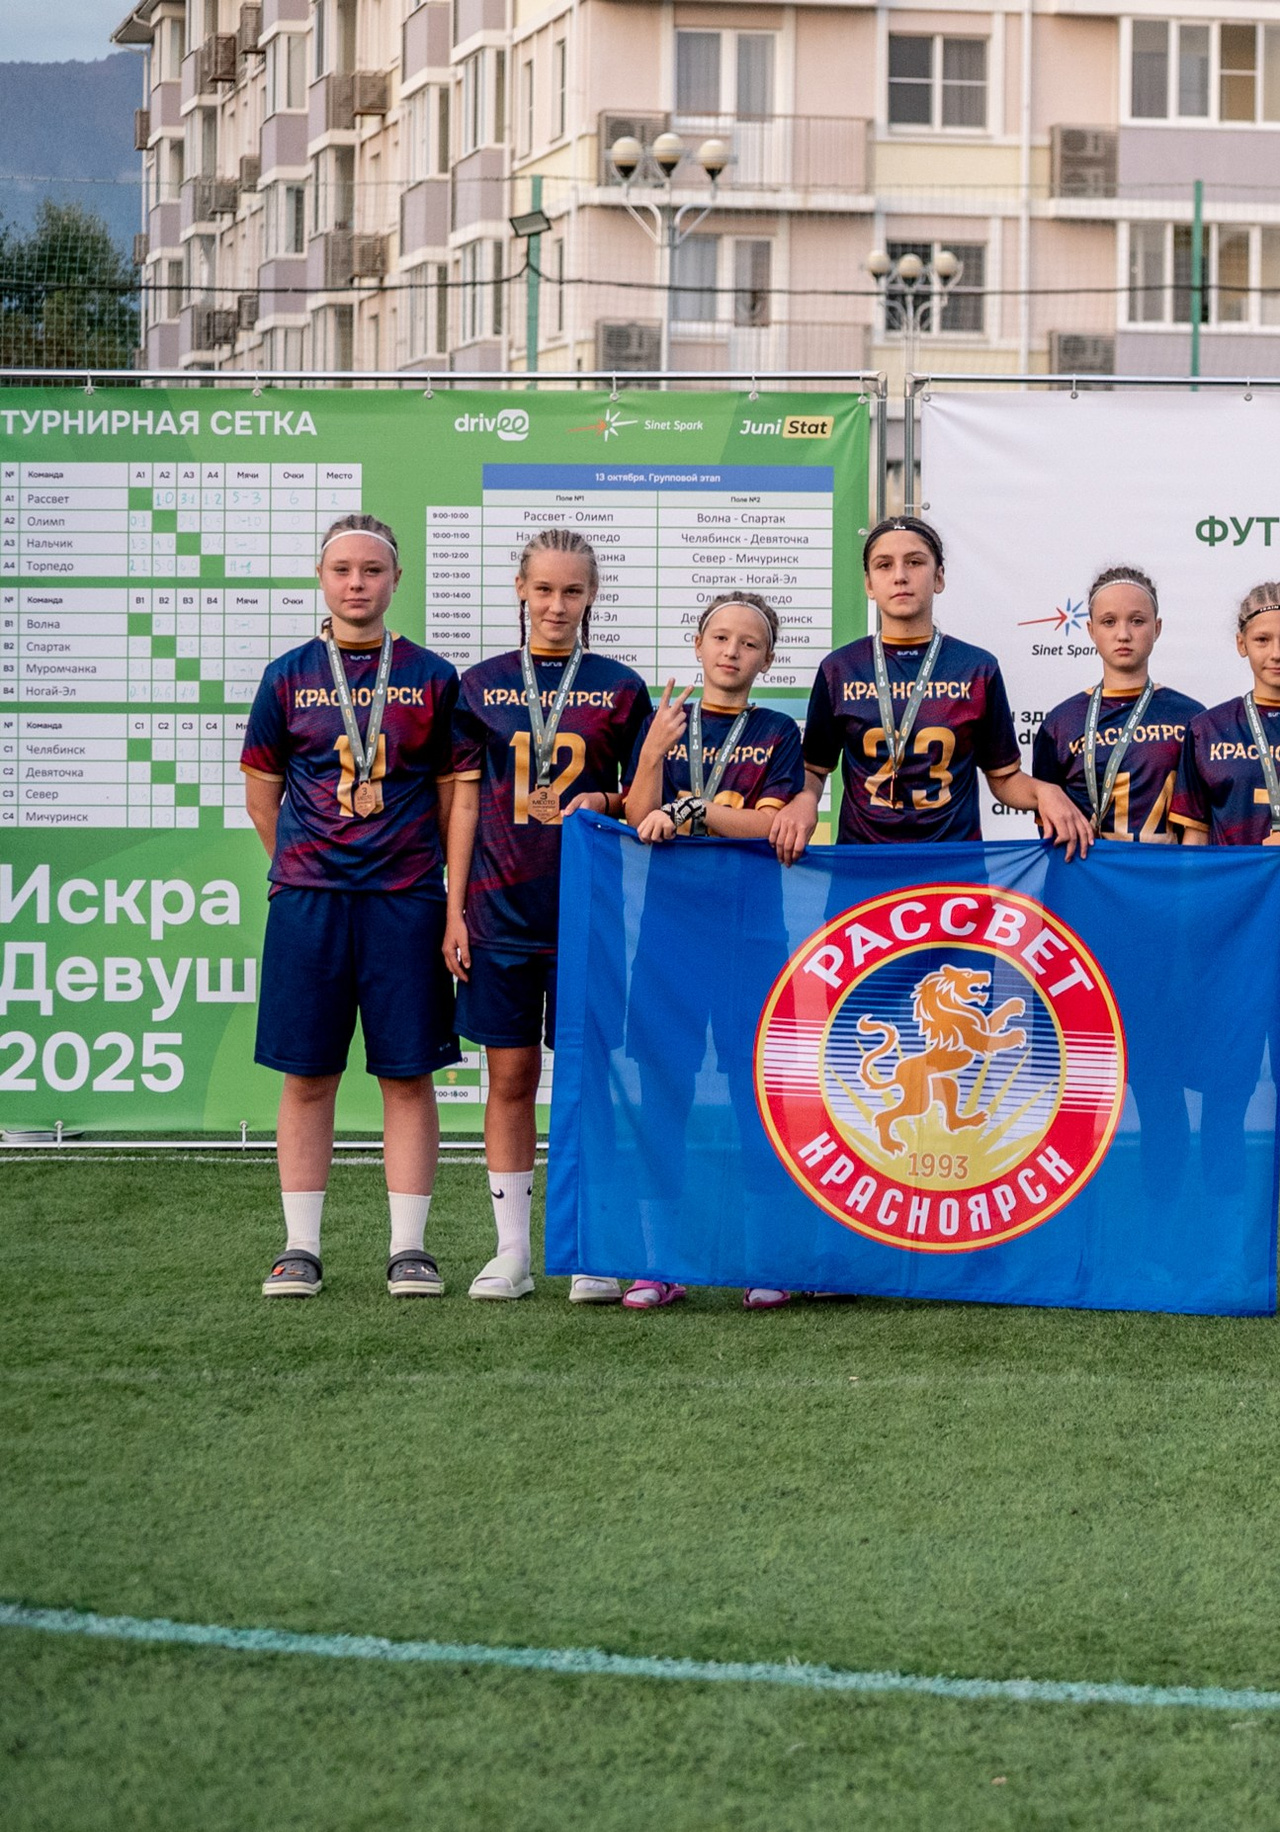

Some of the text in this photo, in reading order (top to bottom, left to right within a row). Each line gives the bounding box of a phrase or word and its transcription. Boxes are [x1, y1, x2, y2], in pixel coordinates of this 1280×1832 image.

[1, 410, 318, 436] ТУРНИРНАЯ СЕТКА
[644, 419, 703, 432] Sinet Spark
[739, 419, 828, 436] Juni Stat
[27, 471, 353, 480] Команда A1 A2 A3 A4 Мячи Очки Место
[595, 473, 721, 484] 13 октября. Групповой этап
[28, 494, 69, 504] Рассвет
[27, 517, 65, 526] Олимп
[524, 512, 613, 522] Рассвет Олимп
[697, 514, 786, 525] Волна Спартак
[27, 538, 73, 548] Нальчик
[681, 533, 809, 545] Челябинск Девяточка
[692, 553, 799, 565] Север Мичуринск
[27, 561, 74, 572] Торпедо
[692, 573, 797, 585] Спартак Ногай-Эл
[27, 597, 304, 606] Команда B1 B2 B3 B4 Мячи Очки
[27, 619, 60, 629] Волна
[26, 642, 71, 653] Спартак
[1032, 645, 1099, 658] Sinet Spar
[26, 663, 97, 676] Муромчанка
[763, 674, 797, 685] Север
[26, 685, 76, 697] Ногай-Эл
[27, 722, 217, 731] Команда C1 C2 C3 C4
[26, 744, 85, 755] Челябинск
[25, 767, 83, 779] Девяточка
[863, 727, 956, 810] 23
[509, 731, 586, 825] 12
[25, 789, 58, 801] Север
[25, 811, 88, 823] Мичуринск
[0, 864, 240, 940] Искра
[803, 897, 1094, 998] РАССВЕТ
[0, 942, 257, 1021] Девуш
[0, 1031, 185, 1093] 2025
[908, 1152, 969, 1180] 1993
[798, 1131, 1075, 1236] КРАСНОЯРСК
